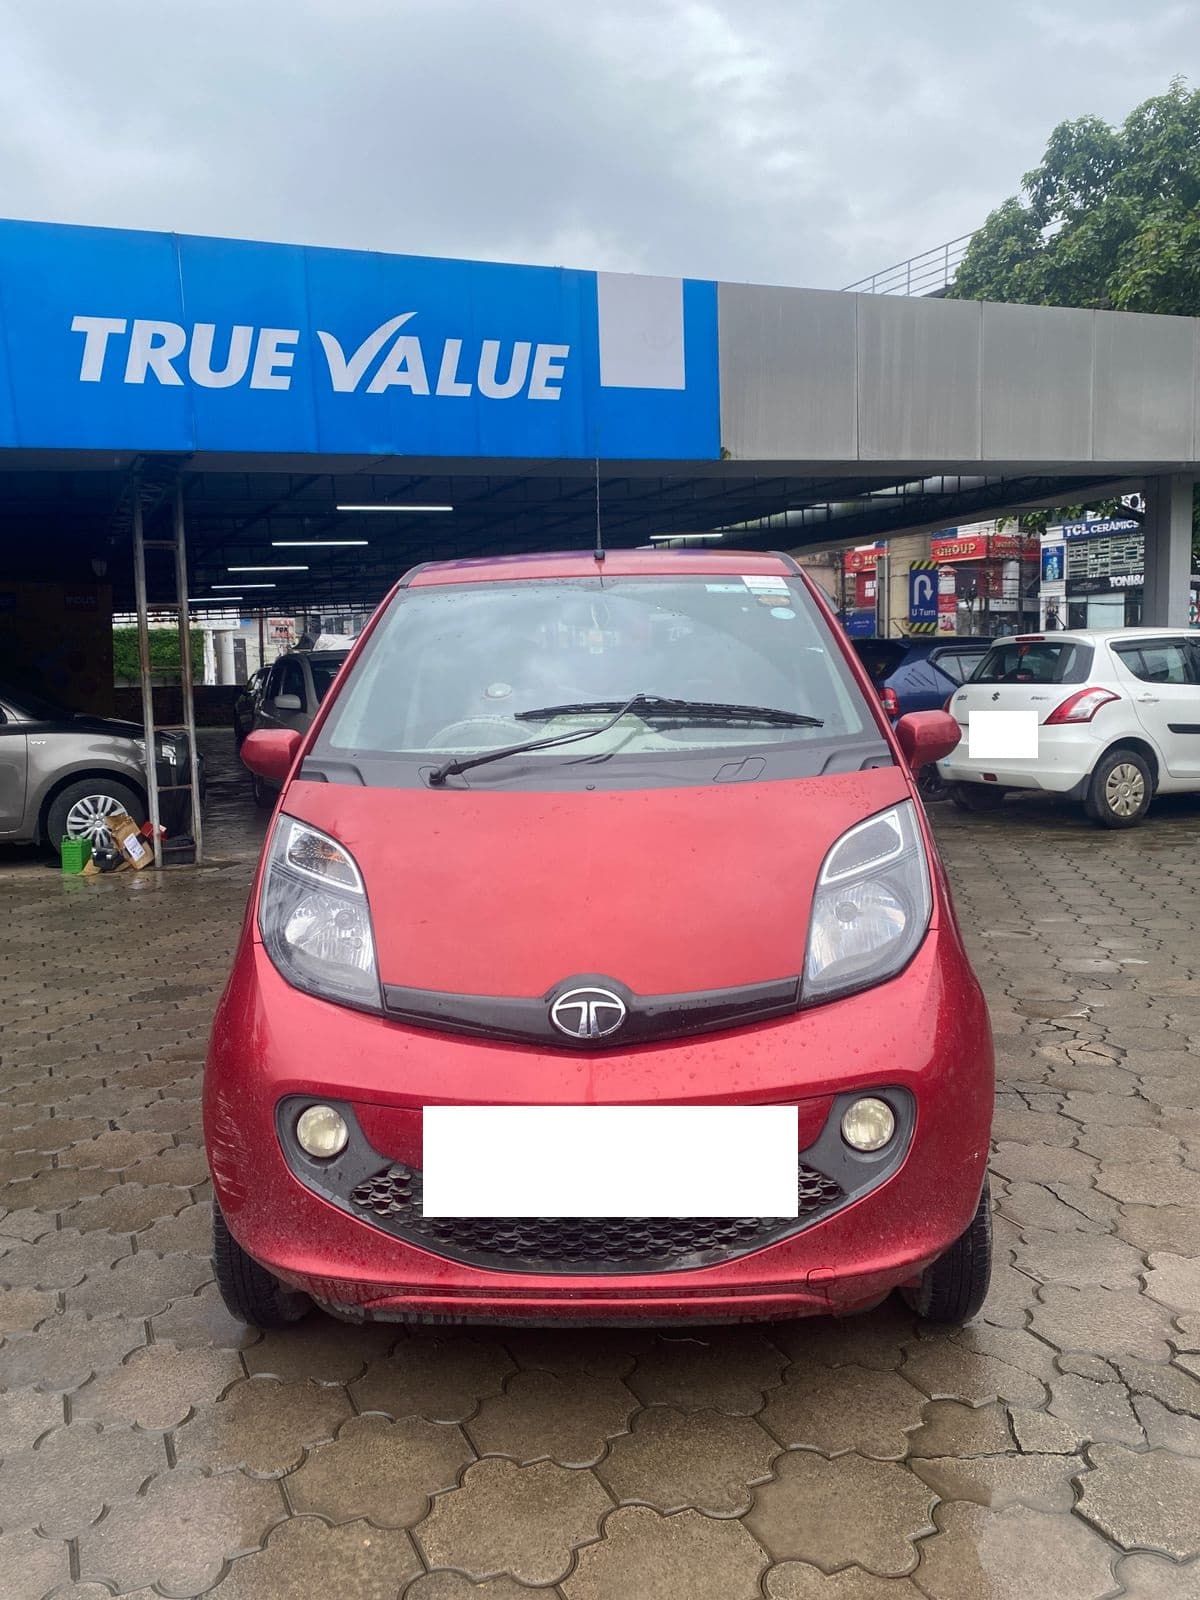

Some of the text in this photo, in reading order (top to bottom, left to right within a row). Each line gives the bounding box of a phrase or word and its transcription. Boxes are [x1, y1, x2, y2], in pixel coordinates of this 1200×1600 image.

[71, 312, 570, 402] TRUE VALUE
[1065, 520, 1140, 537] TCL CERAMICS
[919, 608, 936, 616] Turn
